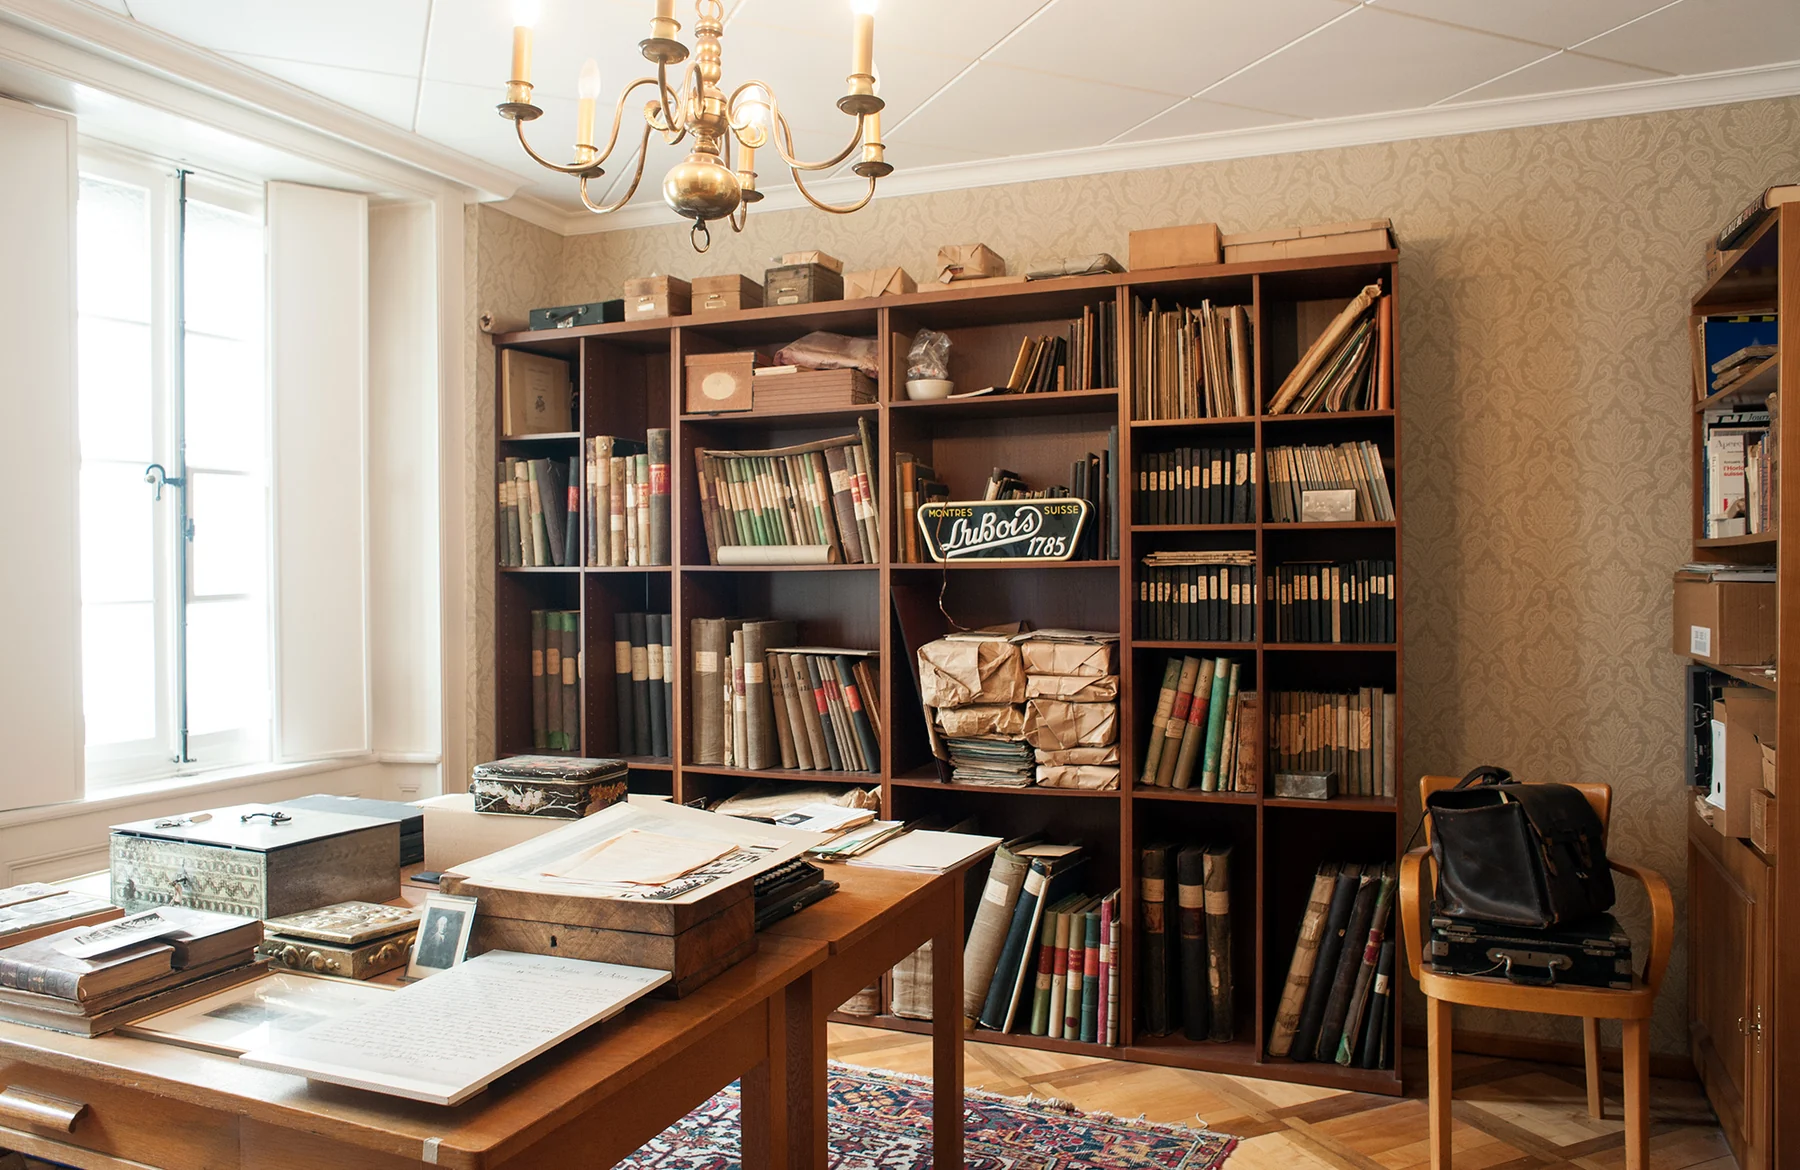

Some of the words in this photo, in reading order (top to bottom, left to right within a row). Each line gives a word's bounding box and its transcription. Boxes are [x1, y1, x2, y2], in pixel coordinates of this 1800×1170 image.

[928, 508, 973, 518] MONTRES
[1044, 505, 1079, 515] SUISSE
[940, 506, 1043, 554] DuBois
[1026, 537, 1066, 556] 1785
